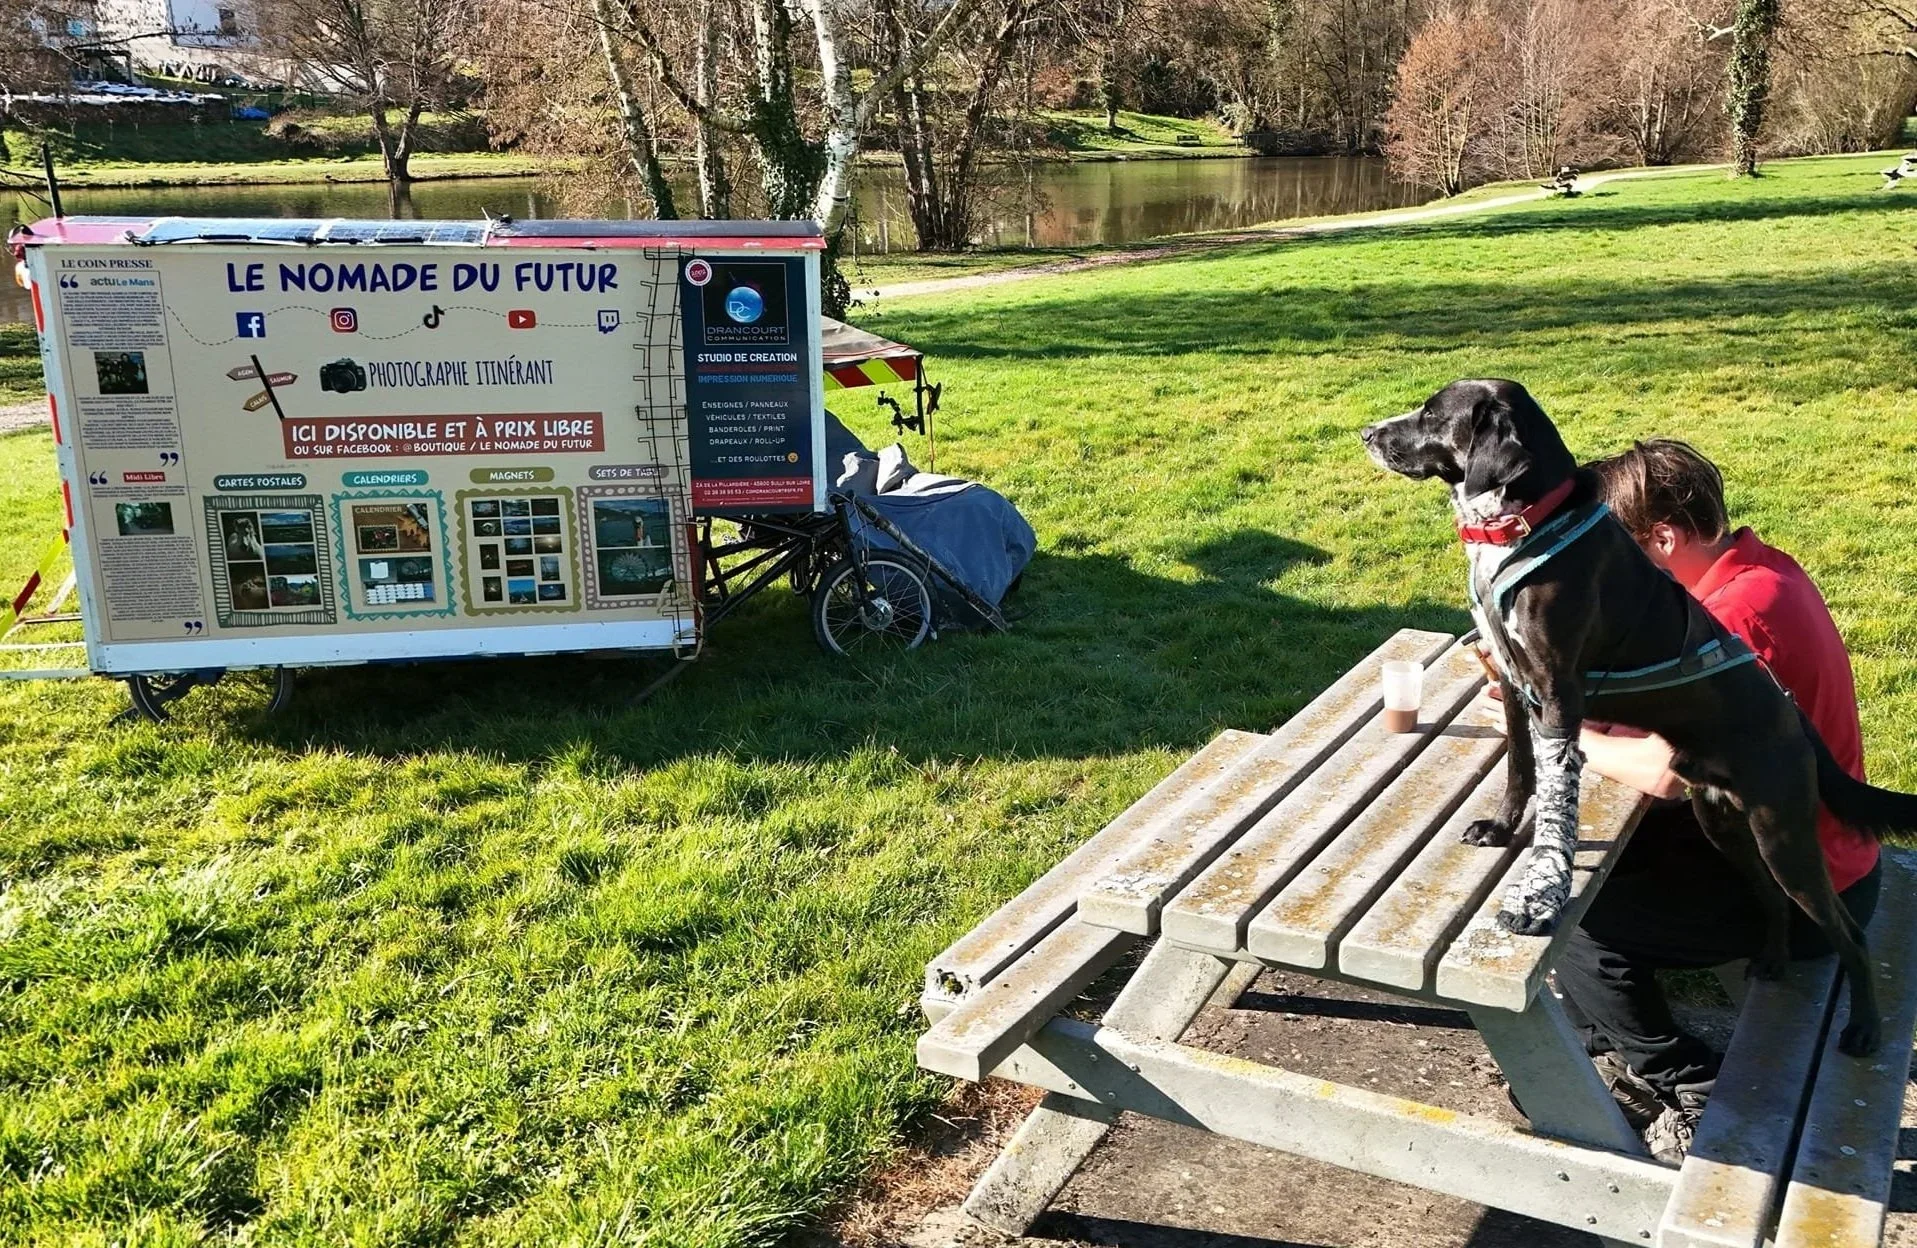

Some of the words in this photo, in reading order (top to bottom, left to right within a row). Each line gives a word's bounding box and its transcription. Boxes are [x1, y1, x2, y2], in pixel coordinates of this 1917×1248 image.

[61, 259, 76, 268] LE
[77, 259, 107, 268] COIN
[109, 259, 153, 268] PRESSE
[90, 277, 116, 286] actu
[129, 278, 155, 286] Mans
[227, 262, 265, 293] LE
[279, 262, 438, 293] NOMADE
[453, 262, 500, 292] DU
[515, 262, 618, 293] FUTUR
[707, 327, 785, 335] DRANCOURT
[697, 353, 732, 362] STUDIO
[734, 353, 748, 362] DE
[749, 353, 798, 362] CREATION
[369, 361, 470, 388] PHOTOGRAPHE
[476, 354, 553, 386] ITINÉRANT
[698, 375, 749, 384] IMPRESSION
[702, 401, 743, 409] ENSEIGNES
[292, 424, 317, 442] ICI
[325, 422, 437, 442] DISPONIBLE
[445, 421, 467, 438] ET
[475, 416, 488, 438] À
[495, 420, 536, 438] PRIX
[544, 419, 594, 437] LIBRE
[293, 445, 309, 455] OU
[313, 444, 333, 455] SUR
[337, 443, 392, 454] FACEBOOK
[480, 441, 491, 450] LE
[494, 440, 540, 450] NOMADE
[543, 440, 558, 449] DU
[561, 439, 593, 449] FUTUR
[489, 470, 535, 481] MAGNETS
[596, 468, 617, 478] SETS
[619, 468, 632, 477] DE
[218, 477, 254, 488] CARTES
[257, 476, 303, 487] POSTALES
[353, 474, 418, 485] CALENDRIERS
[354, 505, 402, 514] CALENDRIER
